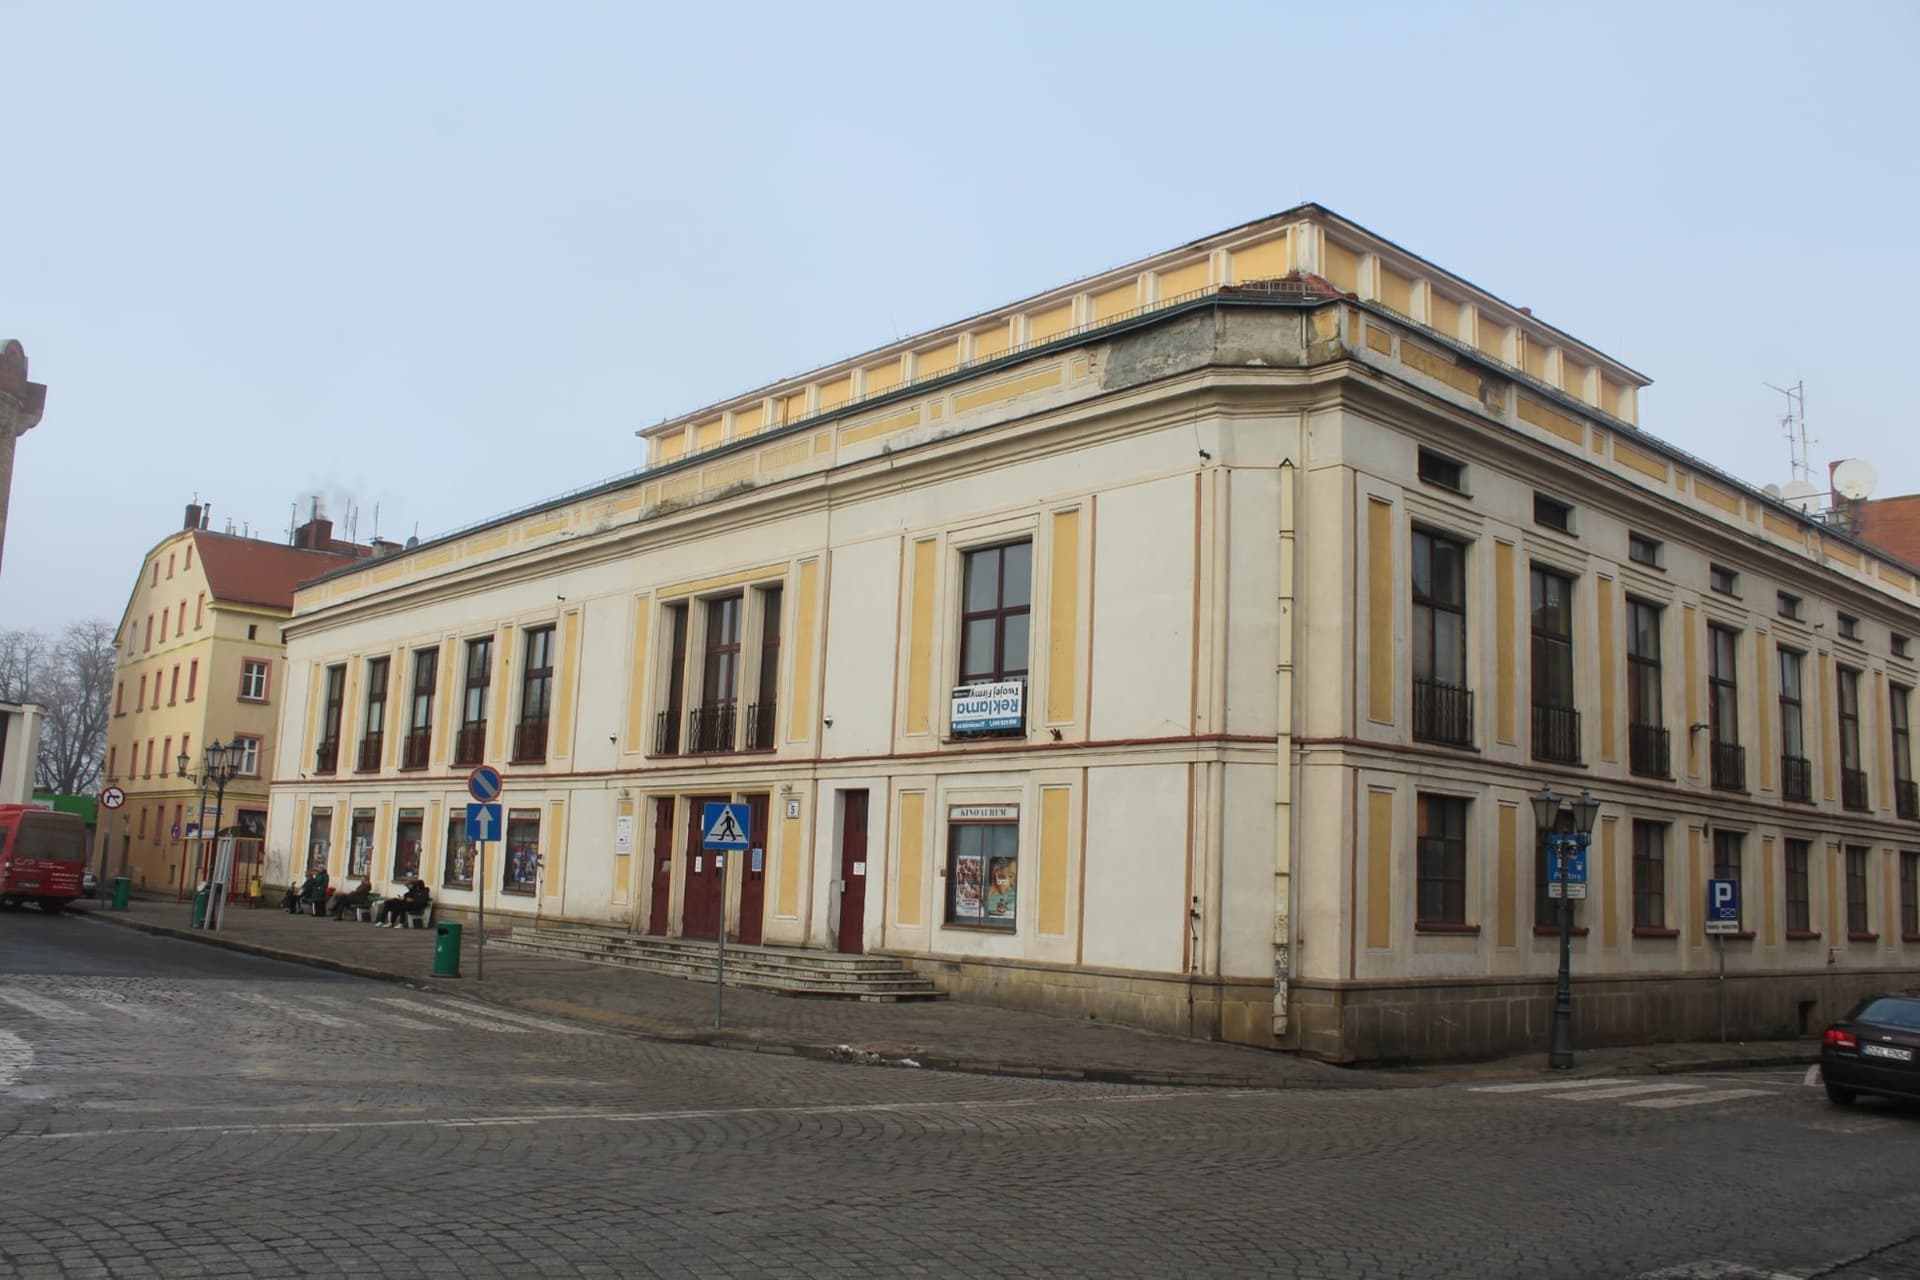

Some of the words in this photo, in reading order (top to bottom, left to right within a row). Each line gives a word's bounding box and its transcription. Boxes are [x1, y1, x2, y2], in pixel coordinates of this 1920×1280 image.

[970, 687, 992, 699] Firmy
[994, 686, 1019, 698] Twojej
[957, 698, 1019, 715] Reklama
[790, 804, 795, 816] 5
[960, 808, 980, 817] KINO
[1715, 882, 1732, 908] P
